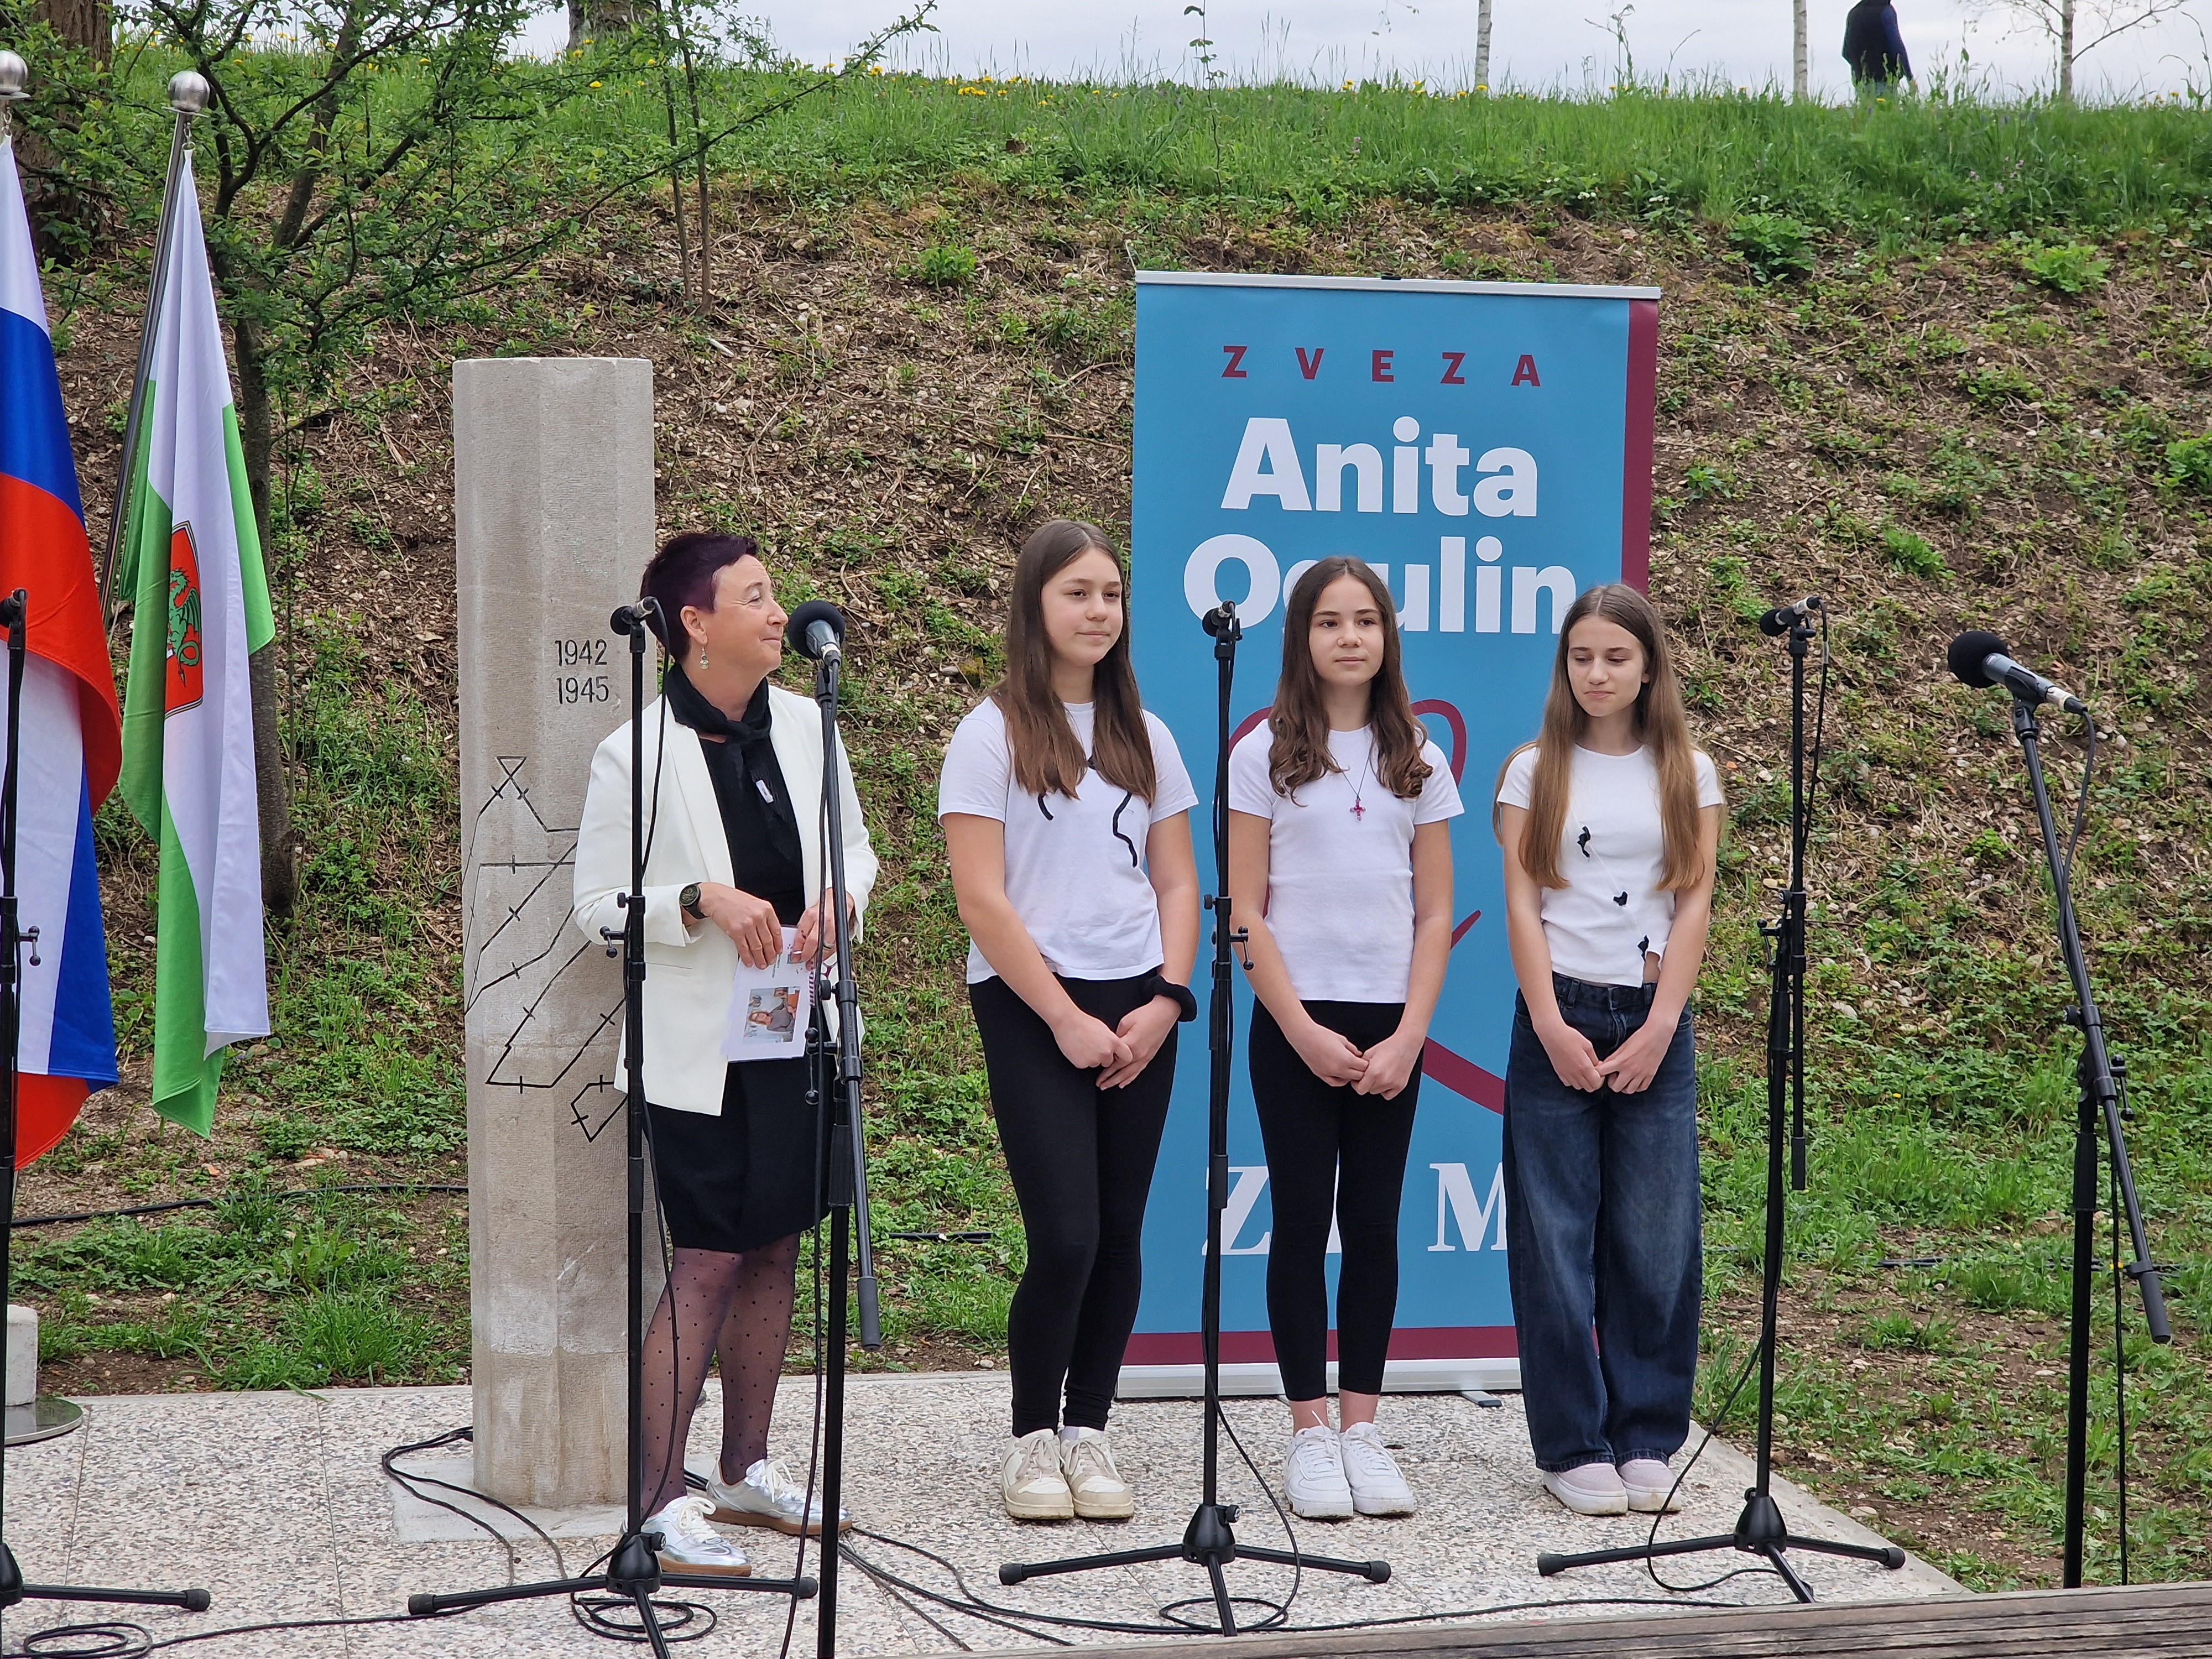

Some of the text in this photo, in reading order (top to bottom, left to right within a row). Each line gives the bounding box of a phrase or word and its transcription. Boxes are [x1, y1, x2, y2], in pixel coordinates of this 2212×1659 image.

[1221, 345, 1541, 387] ZVEZA
[1220, 416, 1538, 517] Anita
[1183, 534, 1577, 635] Oulin
[554, 639, 608, 667] 1942
[556, 676, 609, 705] 1945
